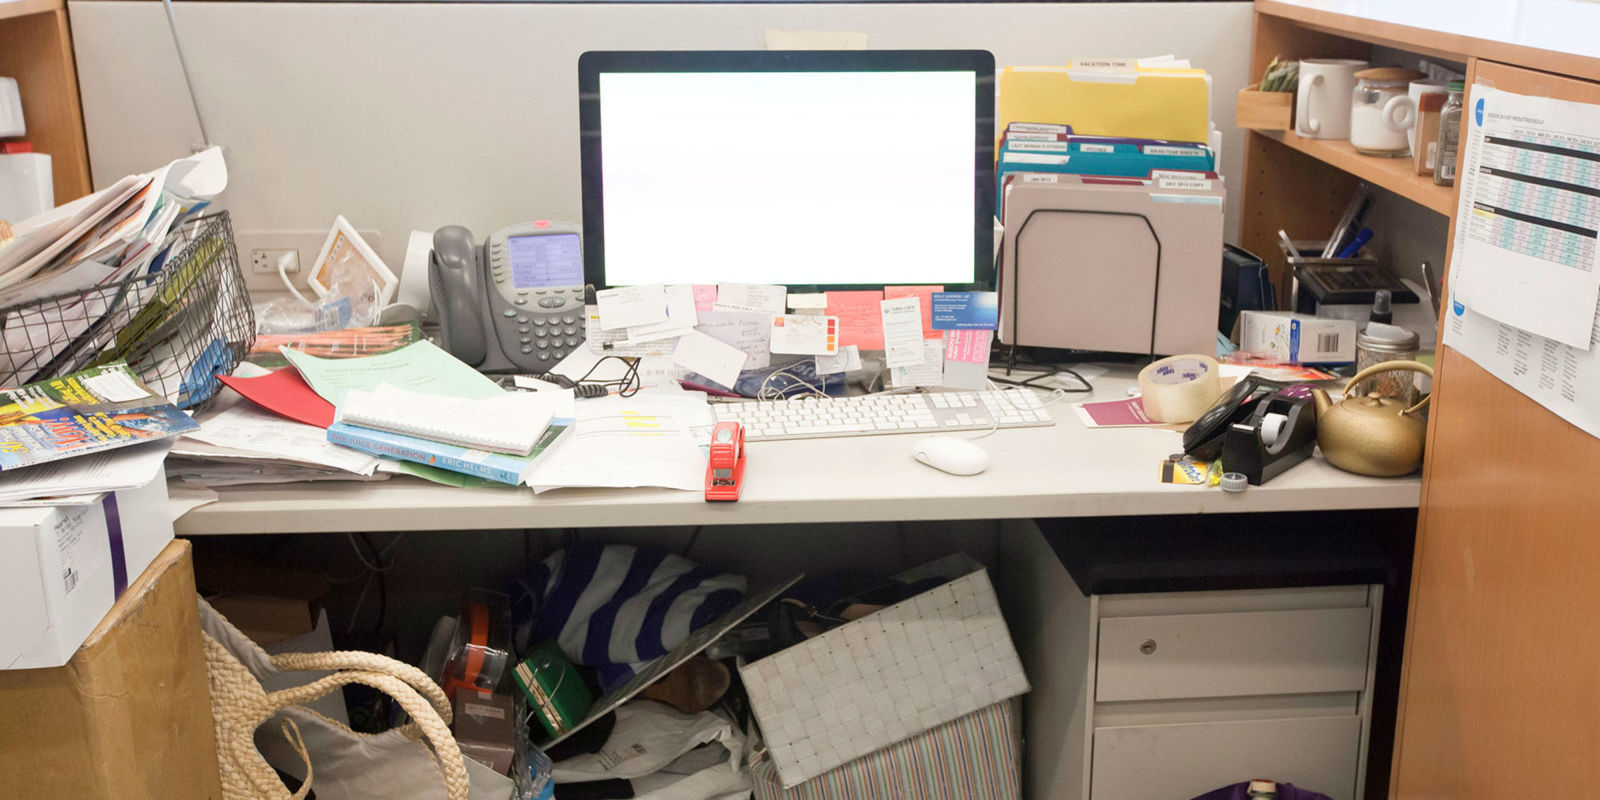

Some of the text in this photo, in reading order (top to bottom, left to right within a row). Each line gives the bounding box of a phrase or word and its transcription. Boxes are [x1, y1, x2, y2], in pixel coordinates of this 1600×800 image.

[332, 432, 346, 443] THE
[350, 437, 371, 448] JUICE
[373, 443, 426, 460] GENERATION
[443, 457, 461, 467] ERIC
